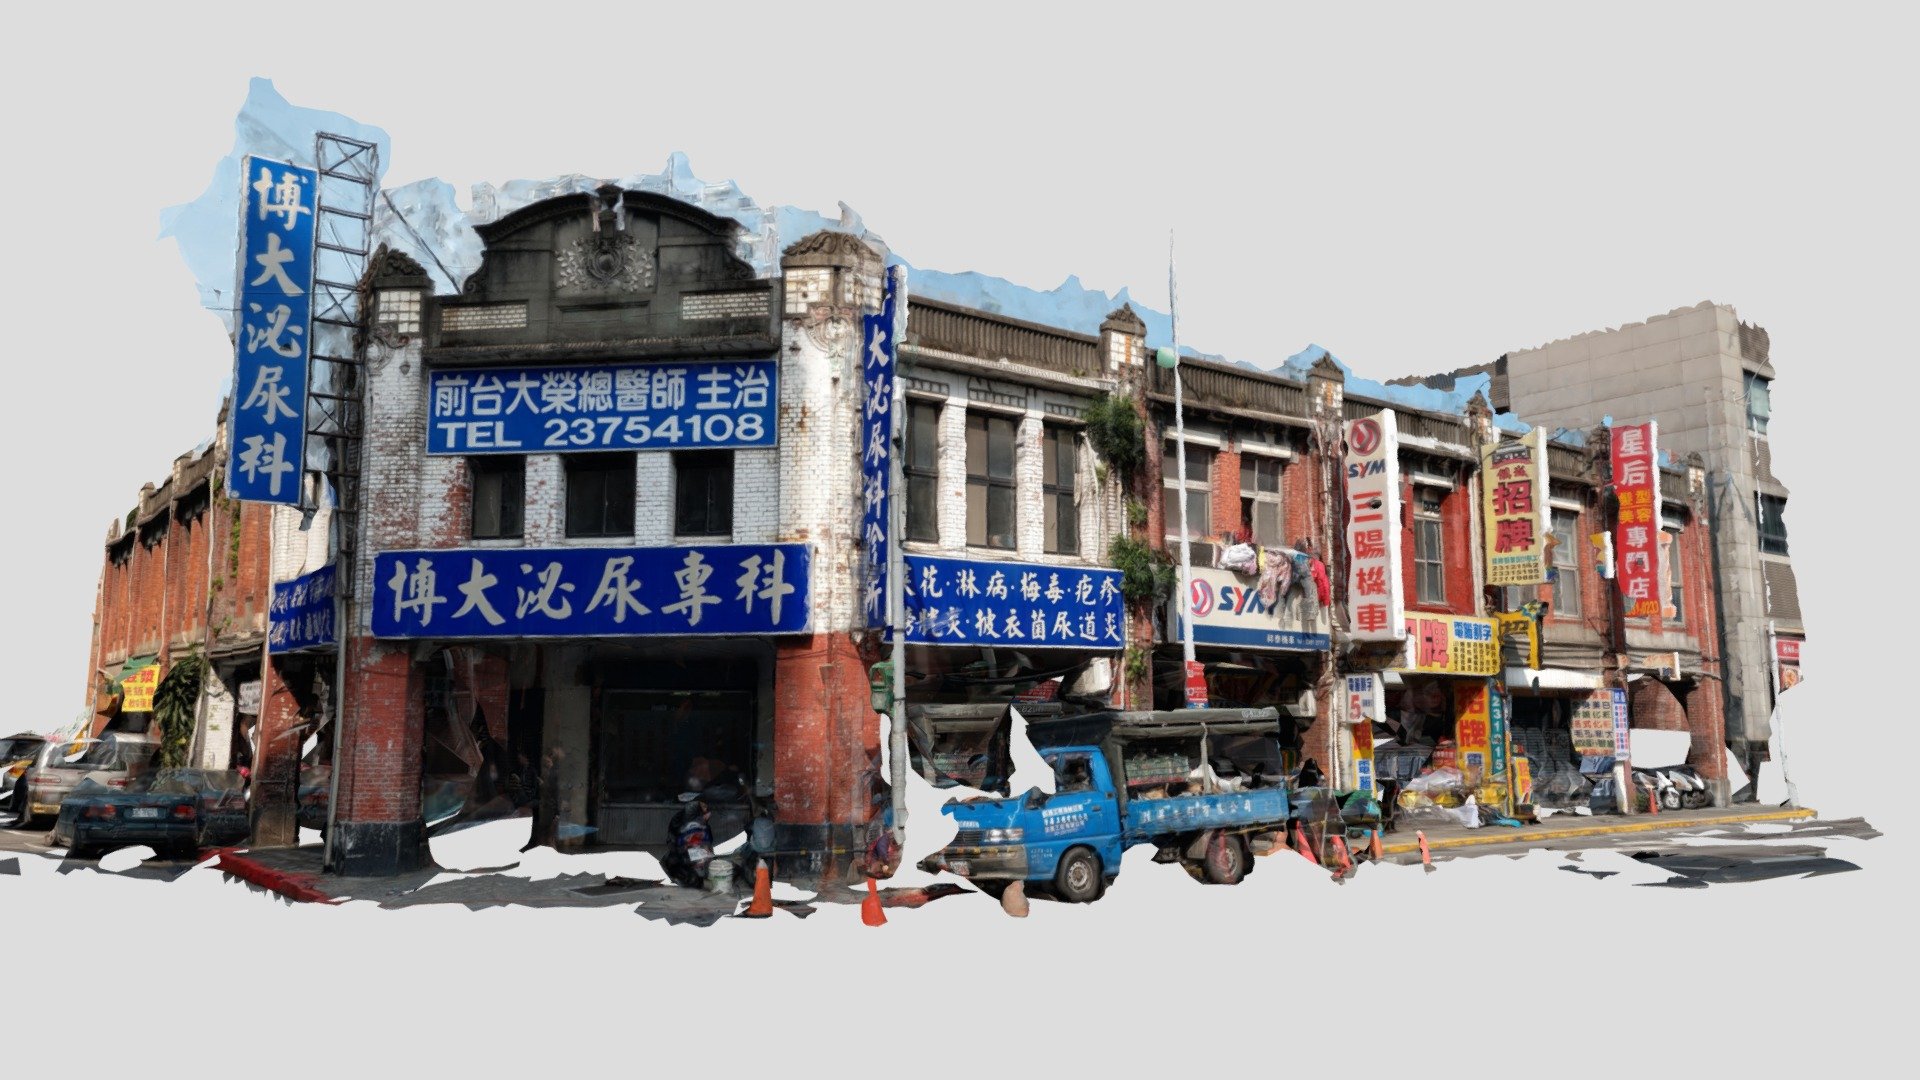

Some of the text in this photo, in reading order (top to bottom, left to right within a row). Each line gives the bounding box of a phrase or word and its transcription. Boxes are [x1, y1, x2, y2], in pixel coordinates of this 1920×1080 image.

[240, 167, 310, 496] 博大泌尿科
[435, 365, 770, 417] 前台大榮總醫師 主治
[437, 413, 764, 448] TEL 23754108
[1619, 428, 1649, 486] 星后
[1348, 459, 1386, 478] SYM
[1492, 479, 1535, 554] 招牌
[388, 549, 796, 627] 博大泌尿專科
[1352, 490, 1388, 632] 三陽機車
[1625, 526, 1650, 599] 專門店
[1350, 694, 1361, 720] 5
